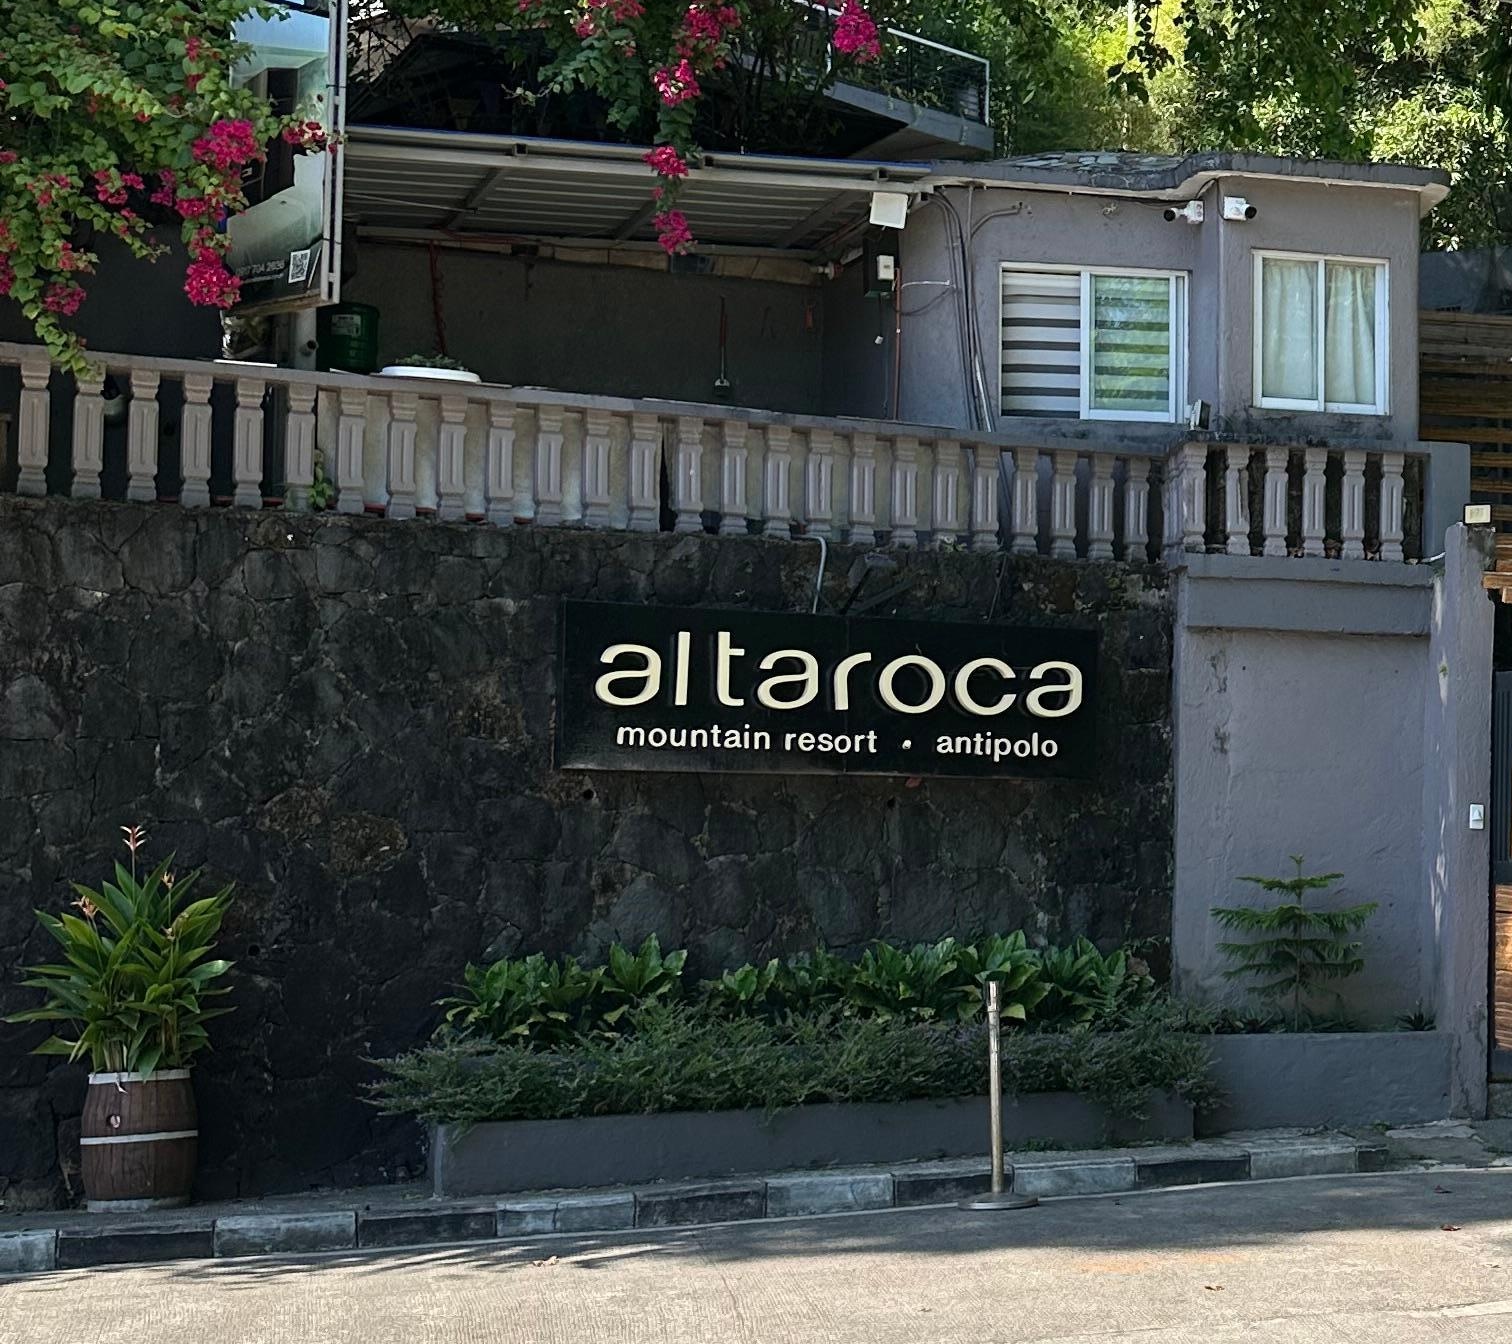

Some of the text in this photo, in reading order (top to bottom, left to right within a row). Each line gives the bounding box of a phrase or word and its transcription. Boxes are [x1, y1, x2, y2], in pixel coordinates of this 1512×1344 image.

[594, 631, 1083, 718] altaroca
[616, 723, 1059, 763] mountain resort antipolo
